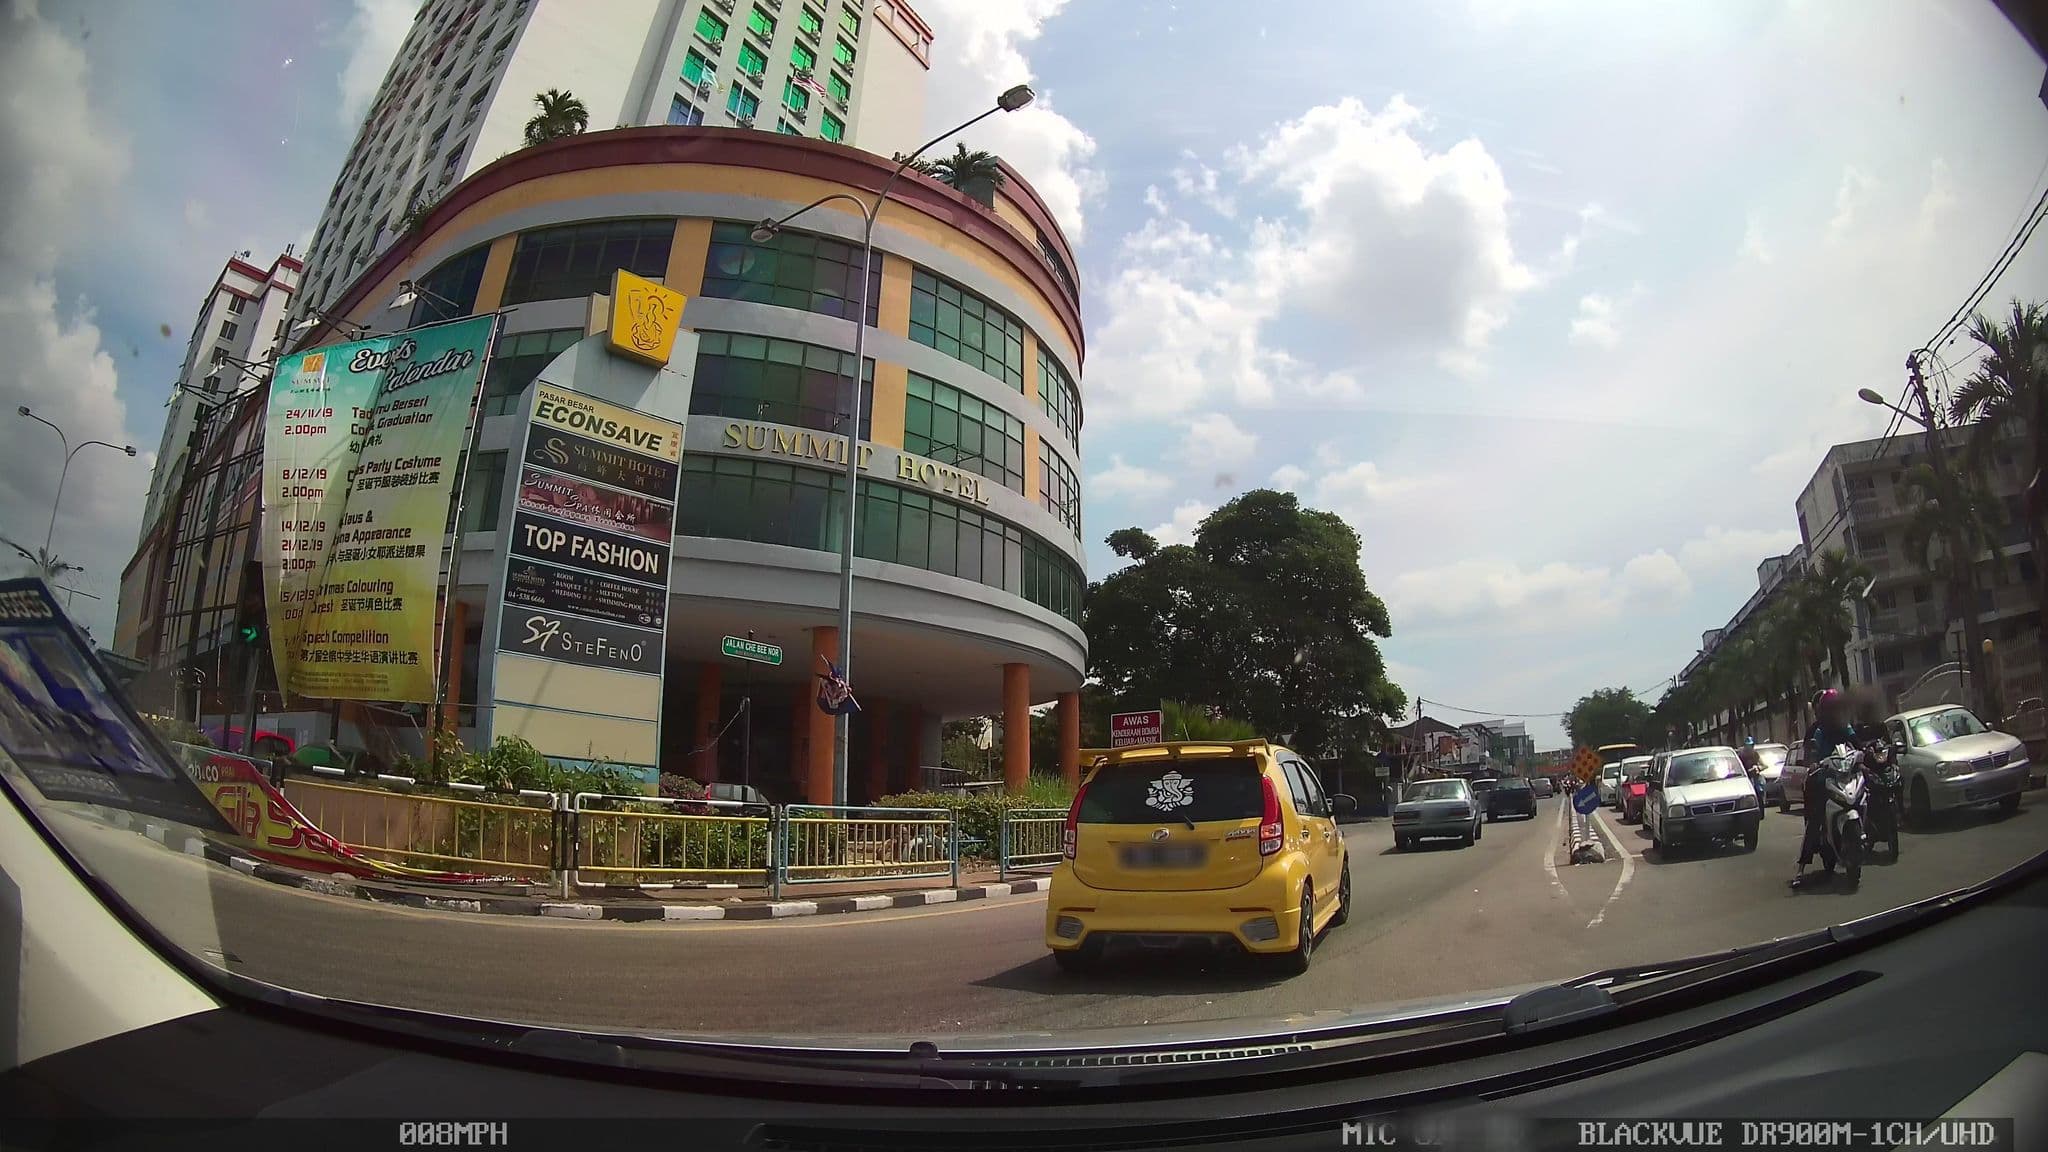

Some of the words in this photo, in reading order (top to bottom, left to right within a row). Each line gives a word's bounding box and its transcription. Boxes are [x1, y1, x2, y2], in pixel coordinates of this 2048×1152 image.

[392, 396, 429, 411] Berseri
[539, 390, 566, 405] PASAR
[567, 398, 594, 414] BESAR
[286, 408, 333, 419] 24/11/19
[377, 412, 433, 429] Graduation
[284, 424, 327, 436] 2.00pm
[535, 400, 662, 452] ECONSAVE
[366, 459, 392, 475] Party
[395, 456, 441, 470] Costume
[574, 444, 627, 467] SUMMIT
[628, 459, 667, 479] HOTEL
[723, 423, 873, 471] SUMMIT
[897, 453, 990, 506] HOTEL
[282, 468, 327, 480] 8/12/19
[282, 486, 323, 499] 2.00pm
[525, 472, 574, 497] SUMMIT
[564, 494, 588, 512] SPA
[281, 521, 326, 533] 14/12/19
[341, 512, 363, 528] laus
[365, 510, 373, 523] &
[352, 527, 411, 545] Appearance
[524, 524, 566, 553] TOP
[571, 535, 659, 574] FASHION
[556, 572, 574, 581] ROOM
[347, 578, 393, 596] Colouring
[555, 580, 582, 591] BANQUET
[555, 589, 581, 599] WEDDING
[332, 630, 389, 647] Competition
[725, 638, 745, 650] JALAN
[745, 643, 756, 652] CHE
[757, 645, 767, 655] BEE
[767, 647, 779, 657] NOR
[1123, 715, 1149, 726] AWAS
